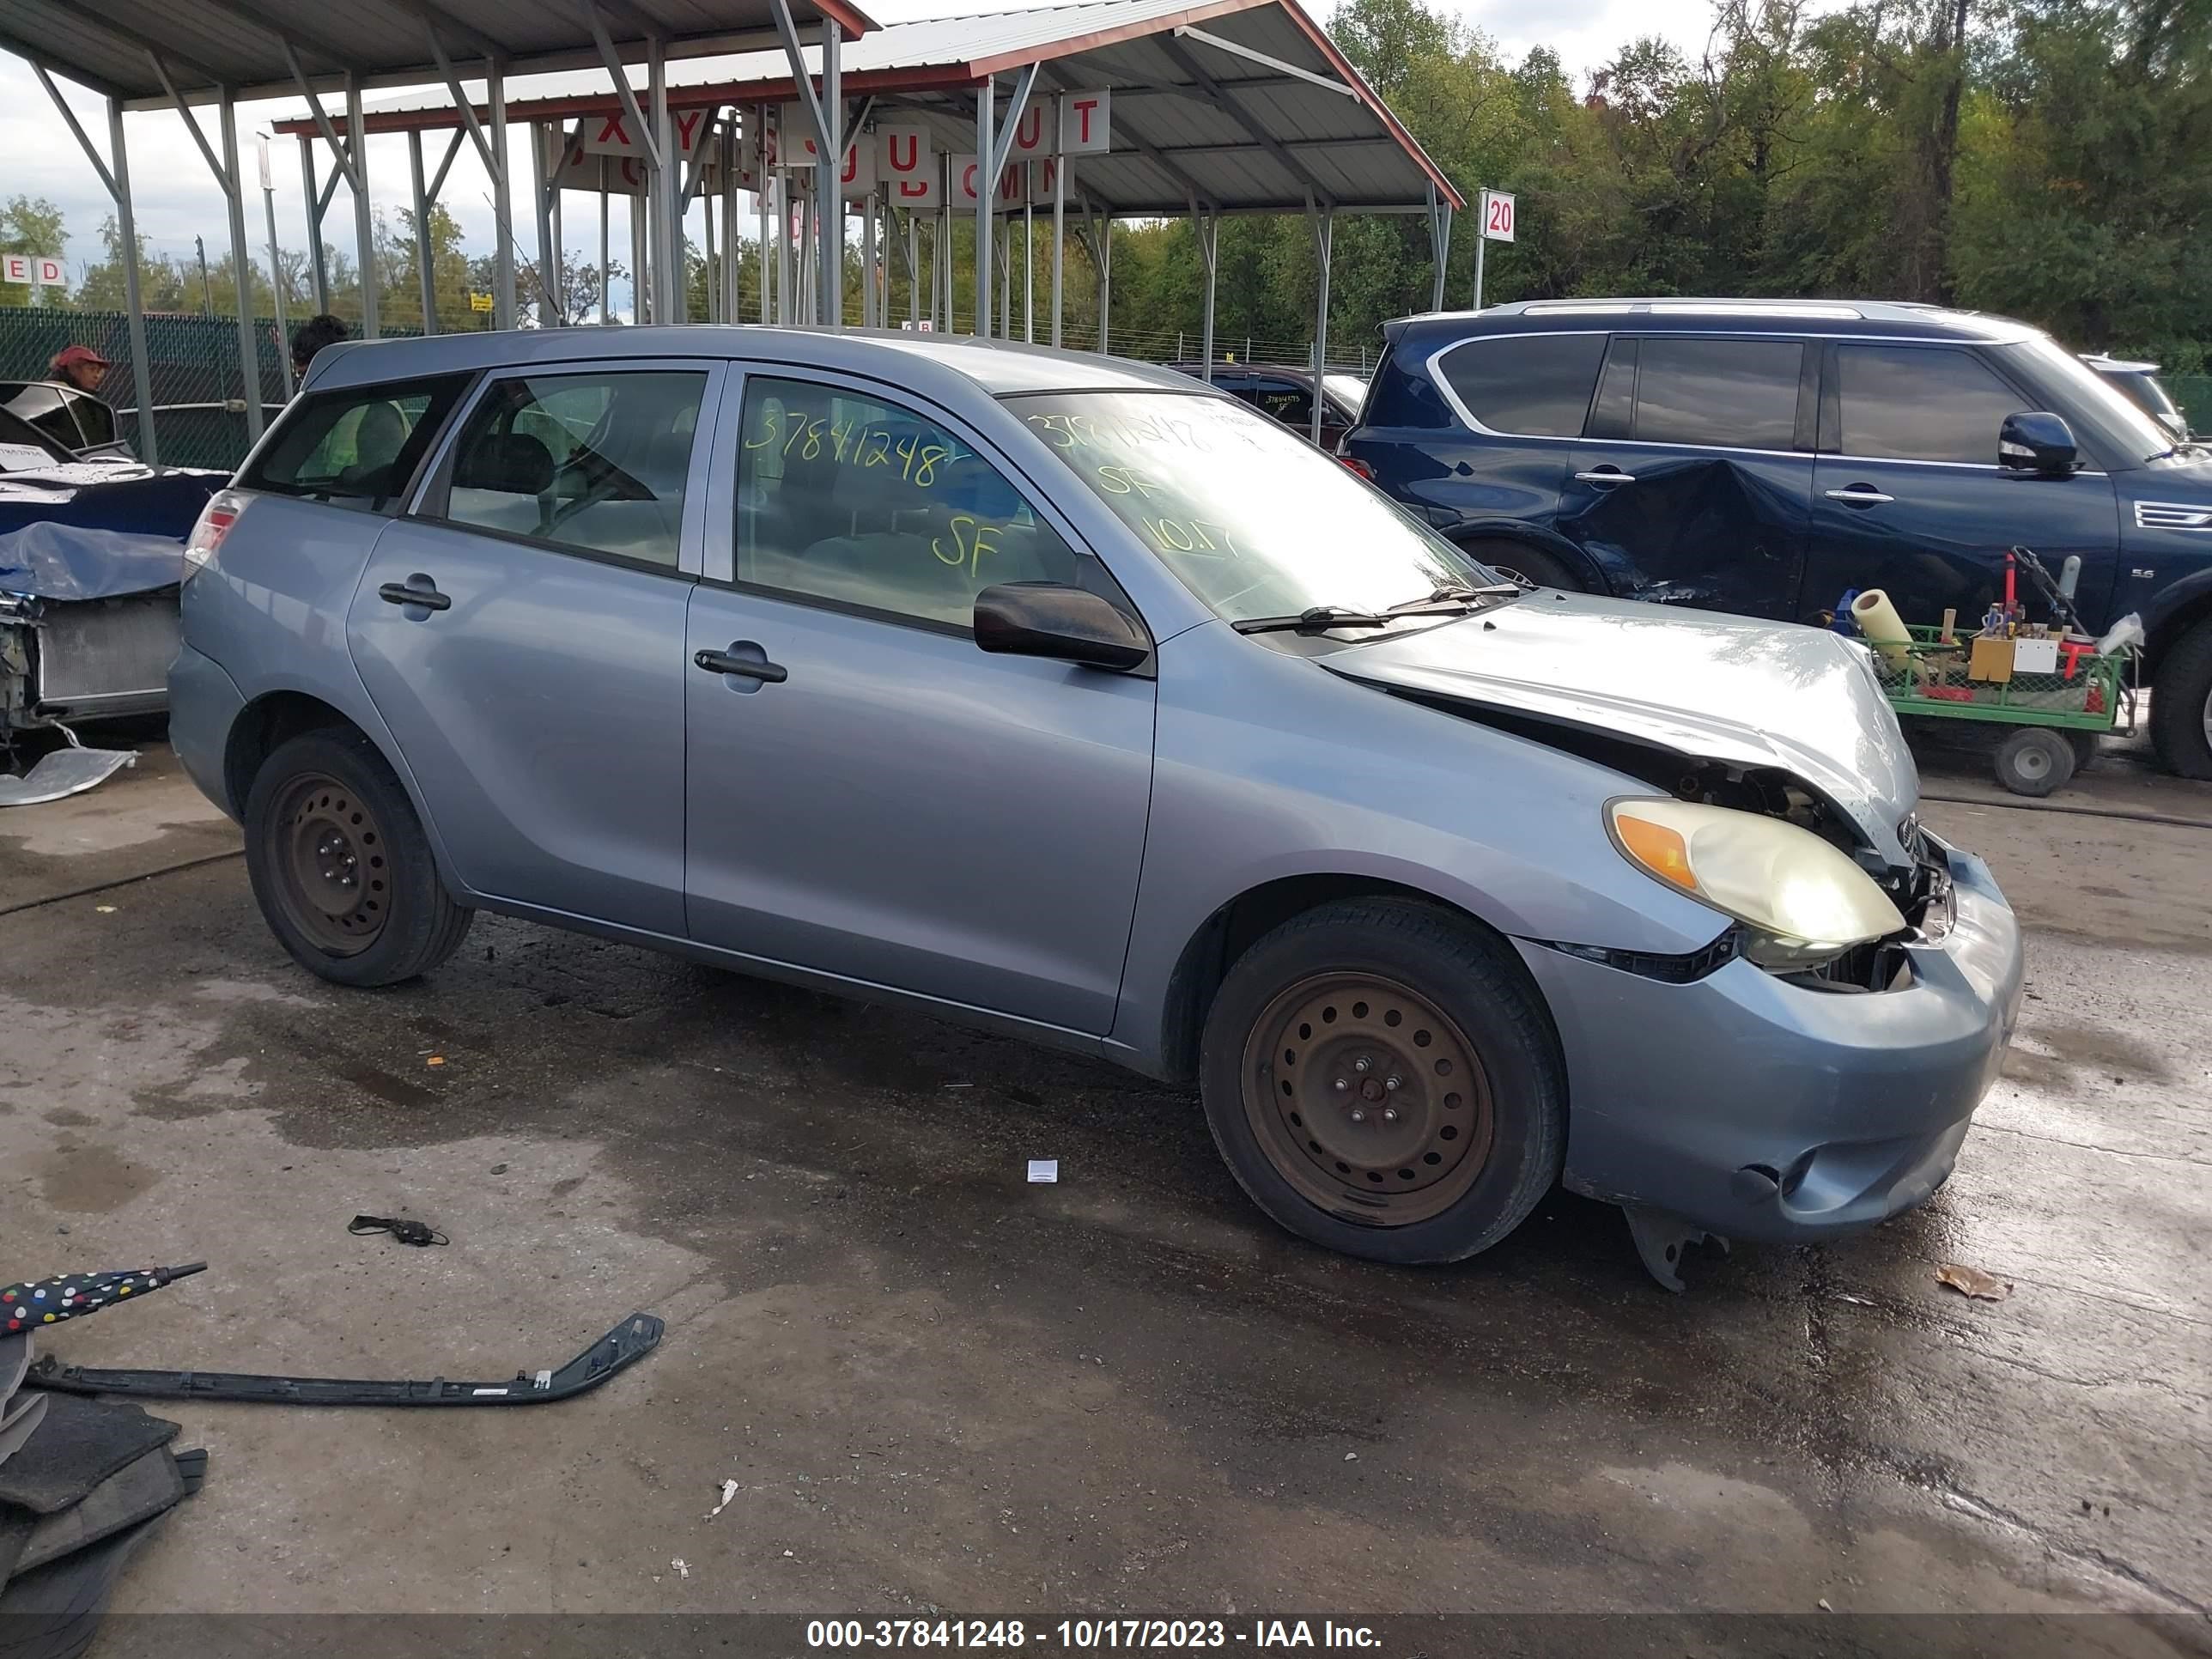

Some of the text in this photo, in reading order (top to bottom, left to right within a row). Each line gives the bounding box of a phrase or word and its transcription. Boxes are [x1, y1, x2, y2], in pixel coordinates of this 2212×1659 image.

[678, 112, 702, 150] Y
[1073, 100, 1098, 143] T
[889, 135, 917, 172] U
[1490, 200, 1511, 233] 20
[10, 260, 25, 278] E
[43, 263, 58, 280] D
[744, 412, 950, 487] 37841248
[932, 516, 1004, 578] SF
